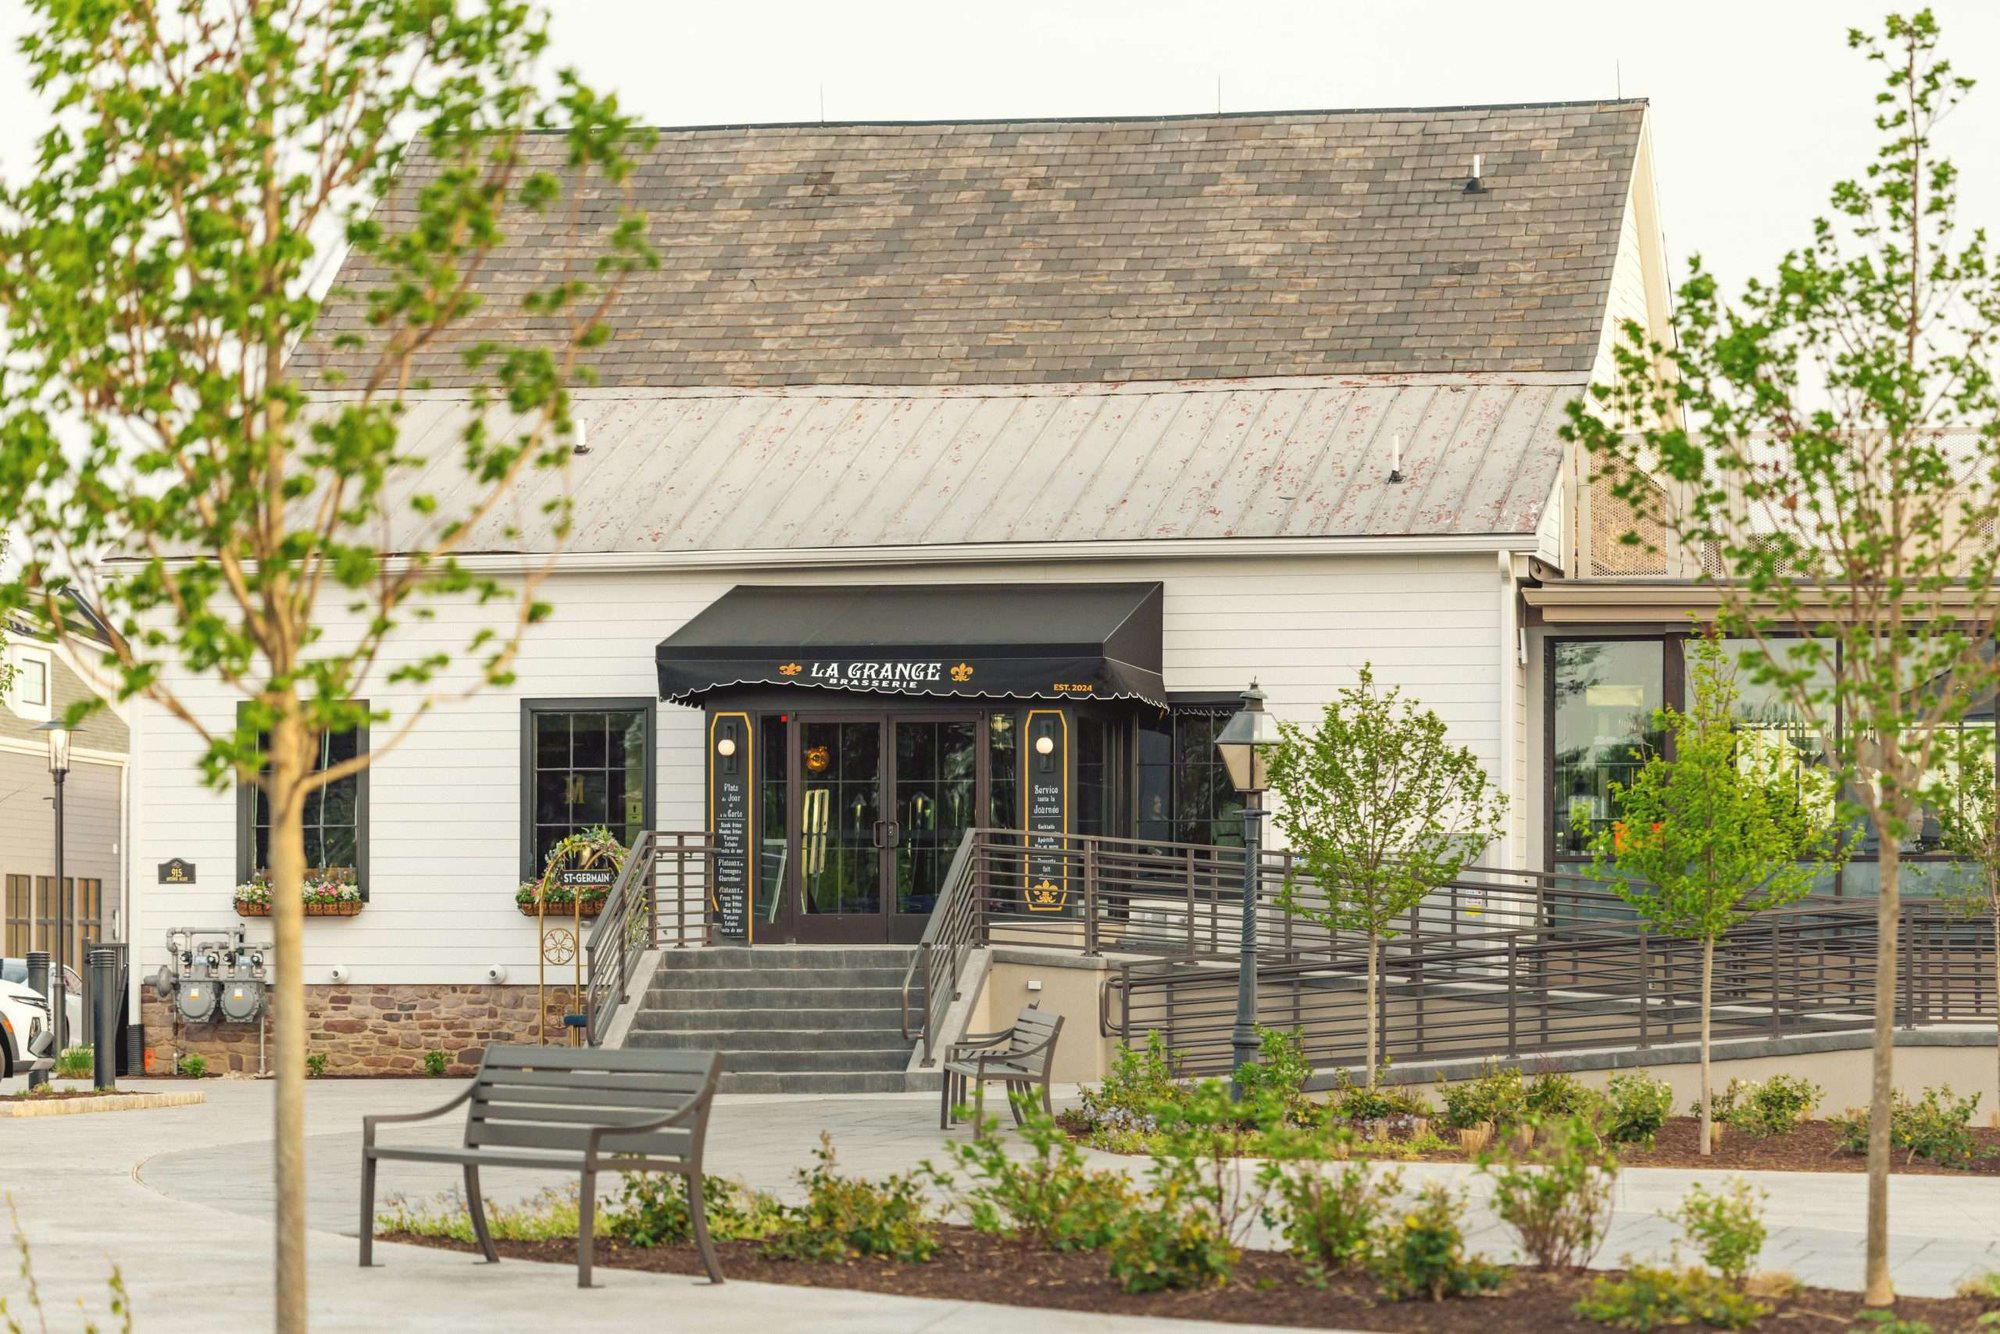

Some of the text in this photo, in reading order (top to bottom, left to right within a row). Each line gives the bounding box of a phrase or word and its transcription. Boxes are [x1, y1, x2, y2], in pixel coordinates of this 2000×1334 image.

[811, 662, 942, 681] LA GRANGE
[829, 678, 923, 689] BRASSERIE
[1053, 683, 1093, 692] EST. 2024
[1034, 784, 1059, 795] Service
[171, 868, 183, 878] 915
[563, 873, 610, 883] ST-GERMAIN
